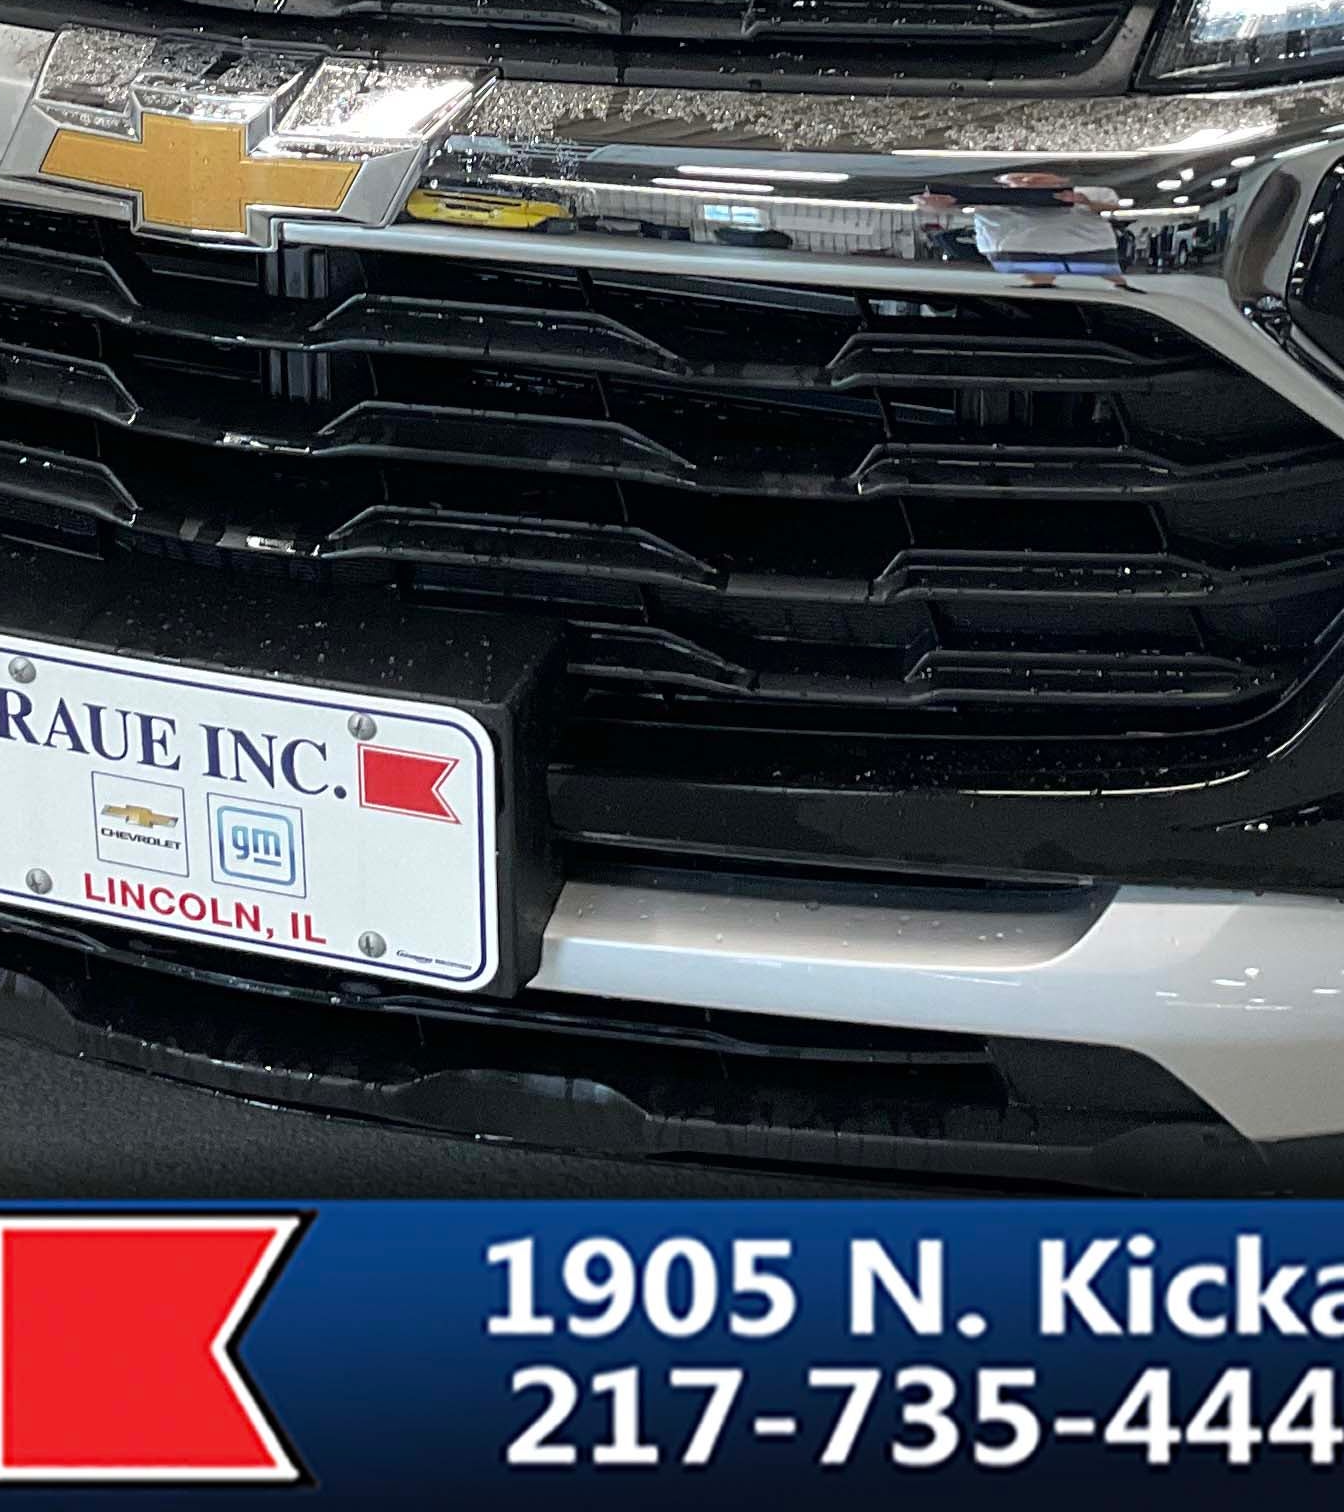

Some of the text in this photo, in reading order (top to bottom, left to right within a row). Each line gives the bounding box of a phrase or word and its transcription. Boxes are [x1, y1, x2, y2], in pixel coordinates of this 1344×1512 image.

[202, 723, 348, 801] INC.
[100, 826, 182, 851] CHEVROLET
[231, 825, 282, 867] gm
[83, 873, 327, 946] LINCOLN, IL
